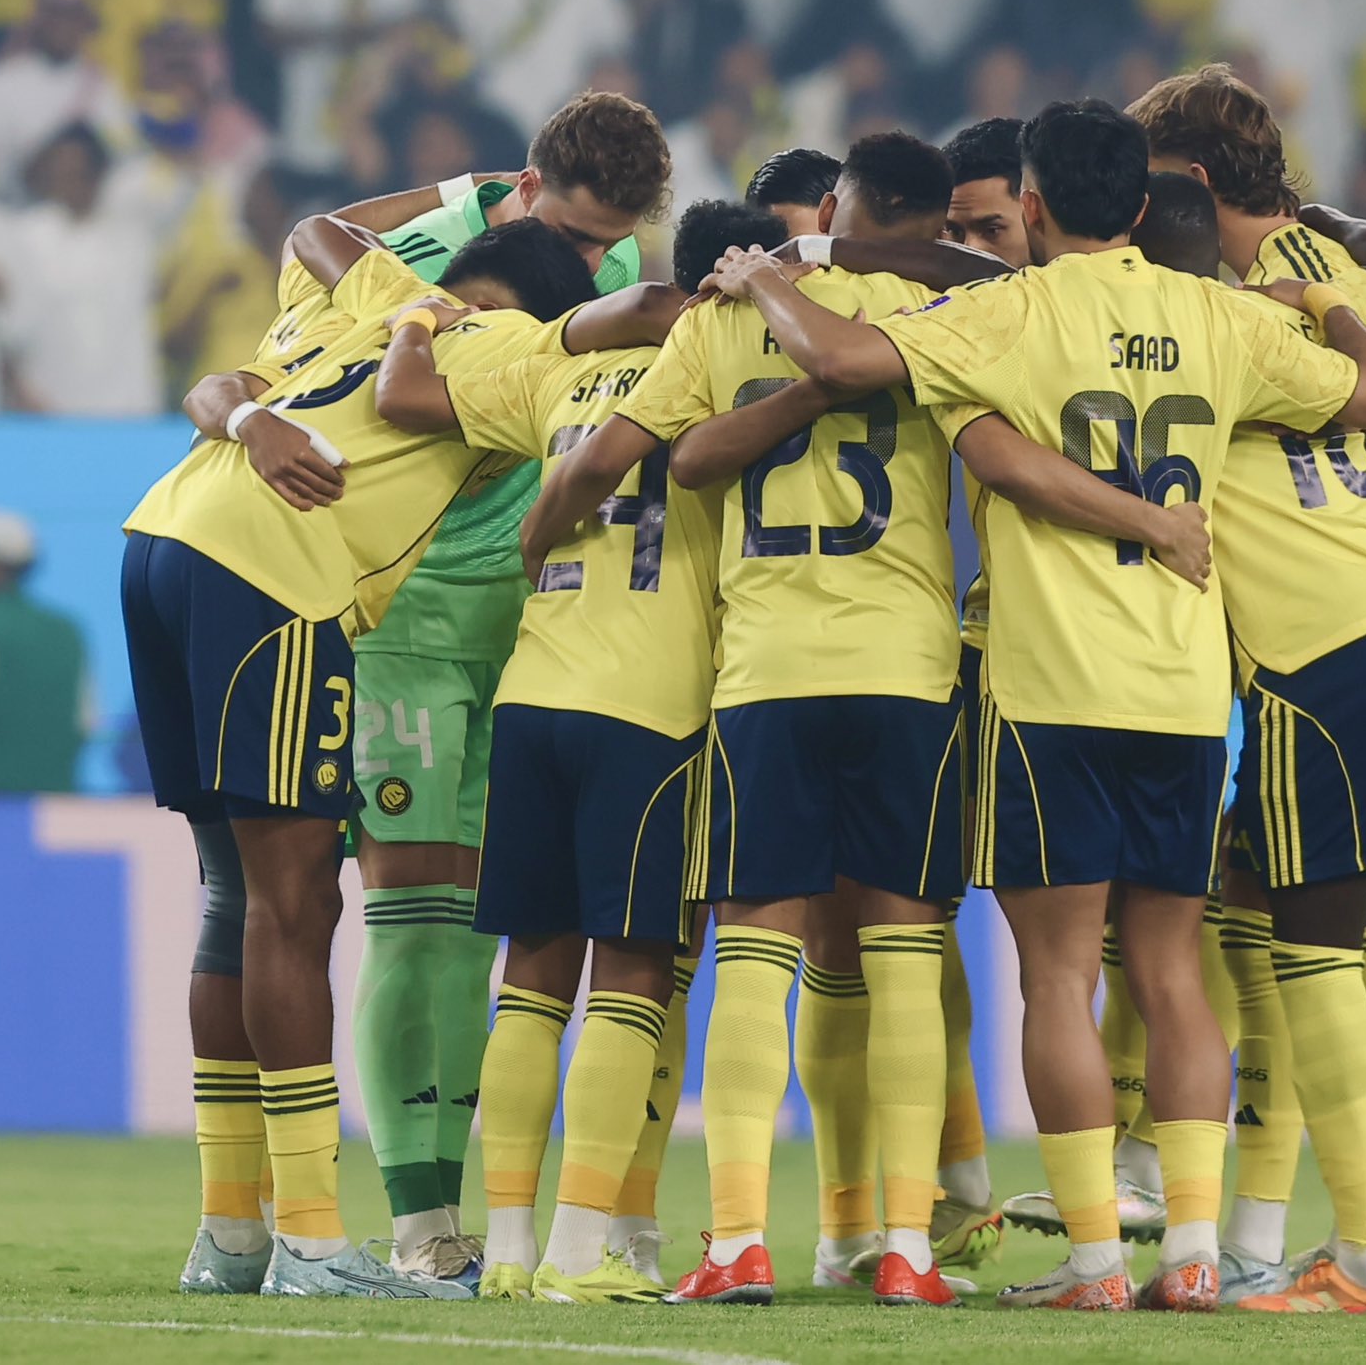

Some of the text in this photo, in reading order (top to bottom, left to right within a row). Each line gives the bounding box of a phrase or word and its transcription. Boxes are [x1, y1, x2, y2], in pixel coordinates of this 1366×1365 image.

[1109, 332, 1180, 372] SAAD
[732, 377, 898, 558] 23
[1060, 390, 1216, 566] 96
[318, 675, 351, 750] 3
[355, 698, 434, 773] 24
